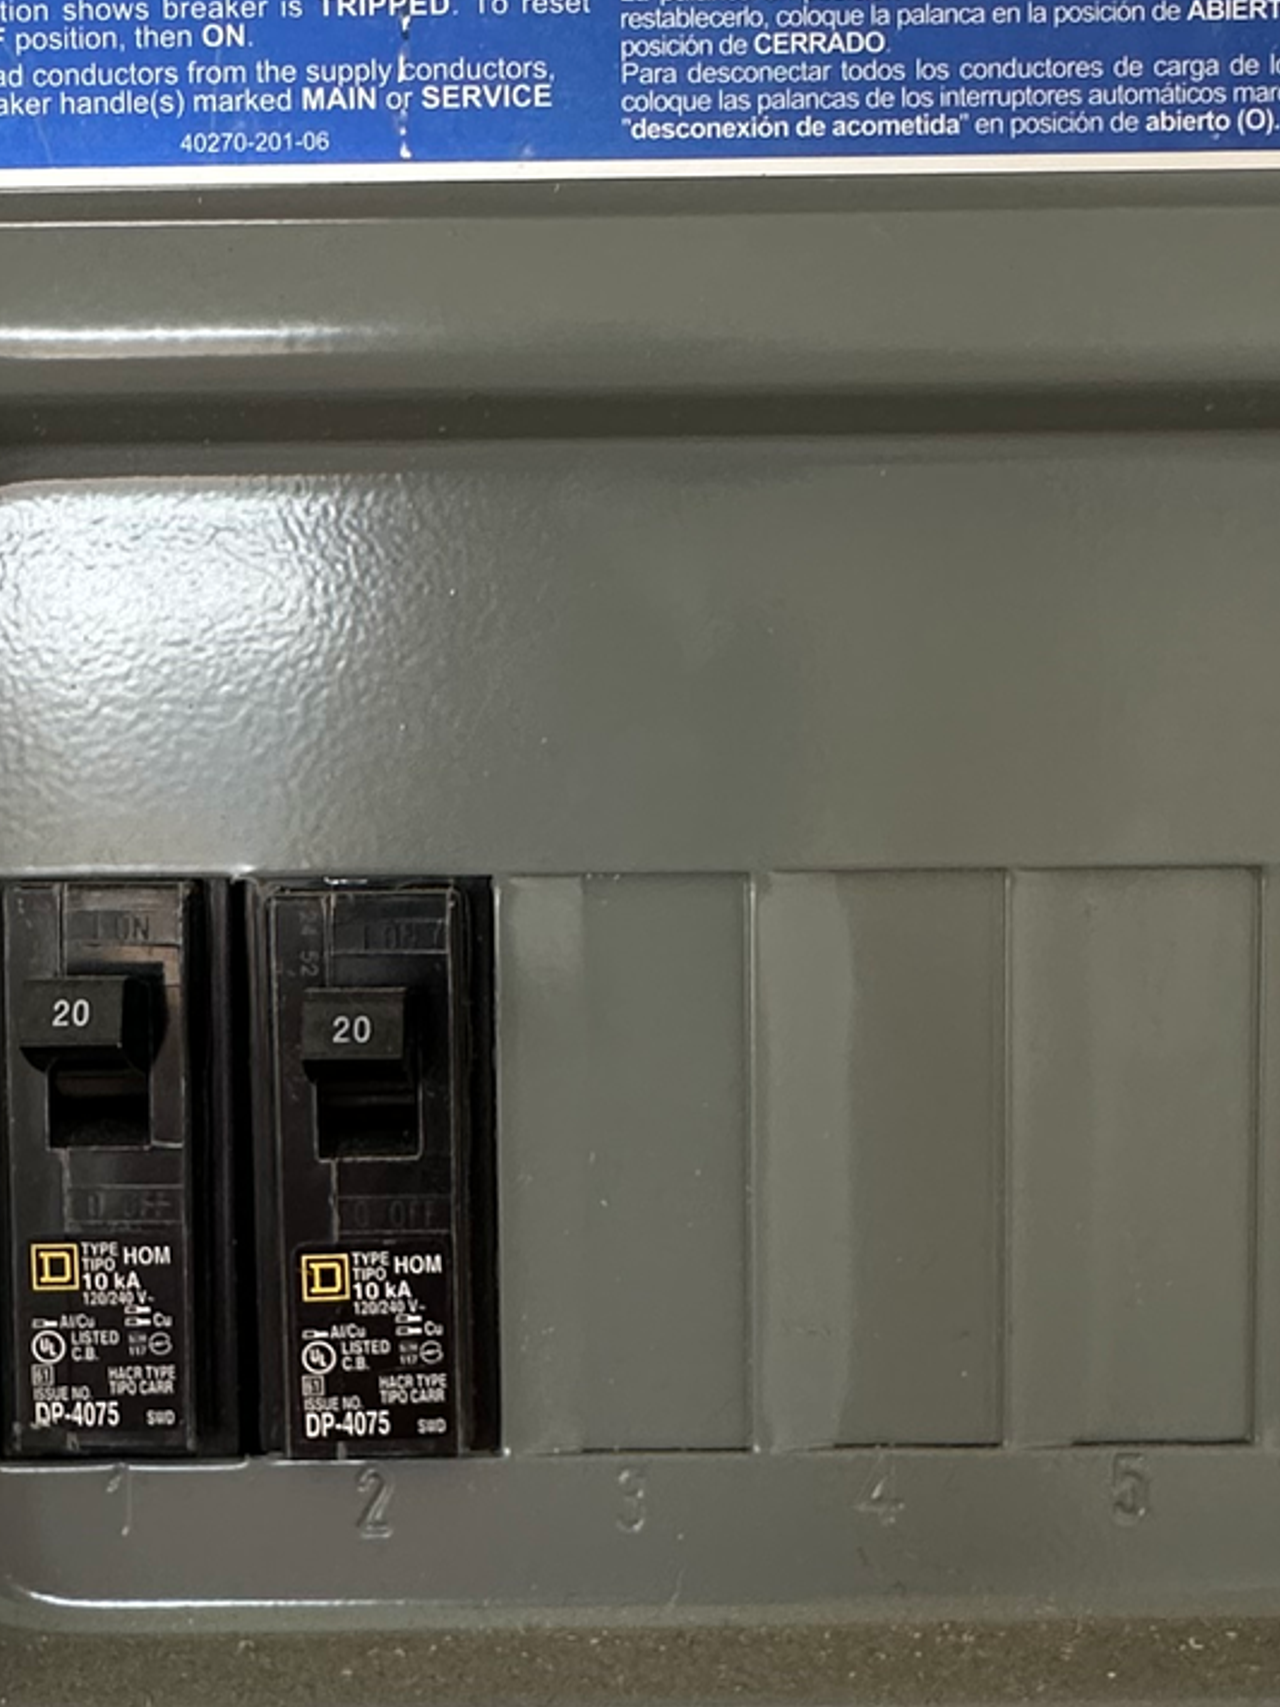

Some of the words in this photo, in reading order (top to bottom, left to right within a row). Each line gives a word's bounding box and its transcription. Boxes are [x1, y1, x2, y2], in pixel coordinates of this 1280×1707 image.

[179, 130, 330, 153] 40270-201-06
[51, 999, 91, 1028] 20
[332, 1015, 372, 1044] 20
[81, 1241, 119, 1257] TYPE
[123, 1246, 171, 1265] HOM
[81, 1258, 116, 1272] TIPO
[351, 1251, 389, 1267] TYPE
[394, 1254, 443, 1274] HOM
[82, 1273, 108, 1290] 10
[114, 1271, 141, 1290] kA
[352, 1267, 387, 1281] TIPO
[83, 1291, 135, 1306] 120/240
[353, 1282, 380, 1300] 10
[385, 1280, 412, 1299] kA
[353, 1301, 406, 1316] 120/240
[34, 1401, 120, 1428] DP-4075
[305, 1411, 391, 1438] DP-4075
[356, 1462, 394, 1539] 2
